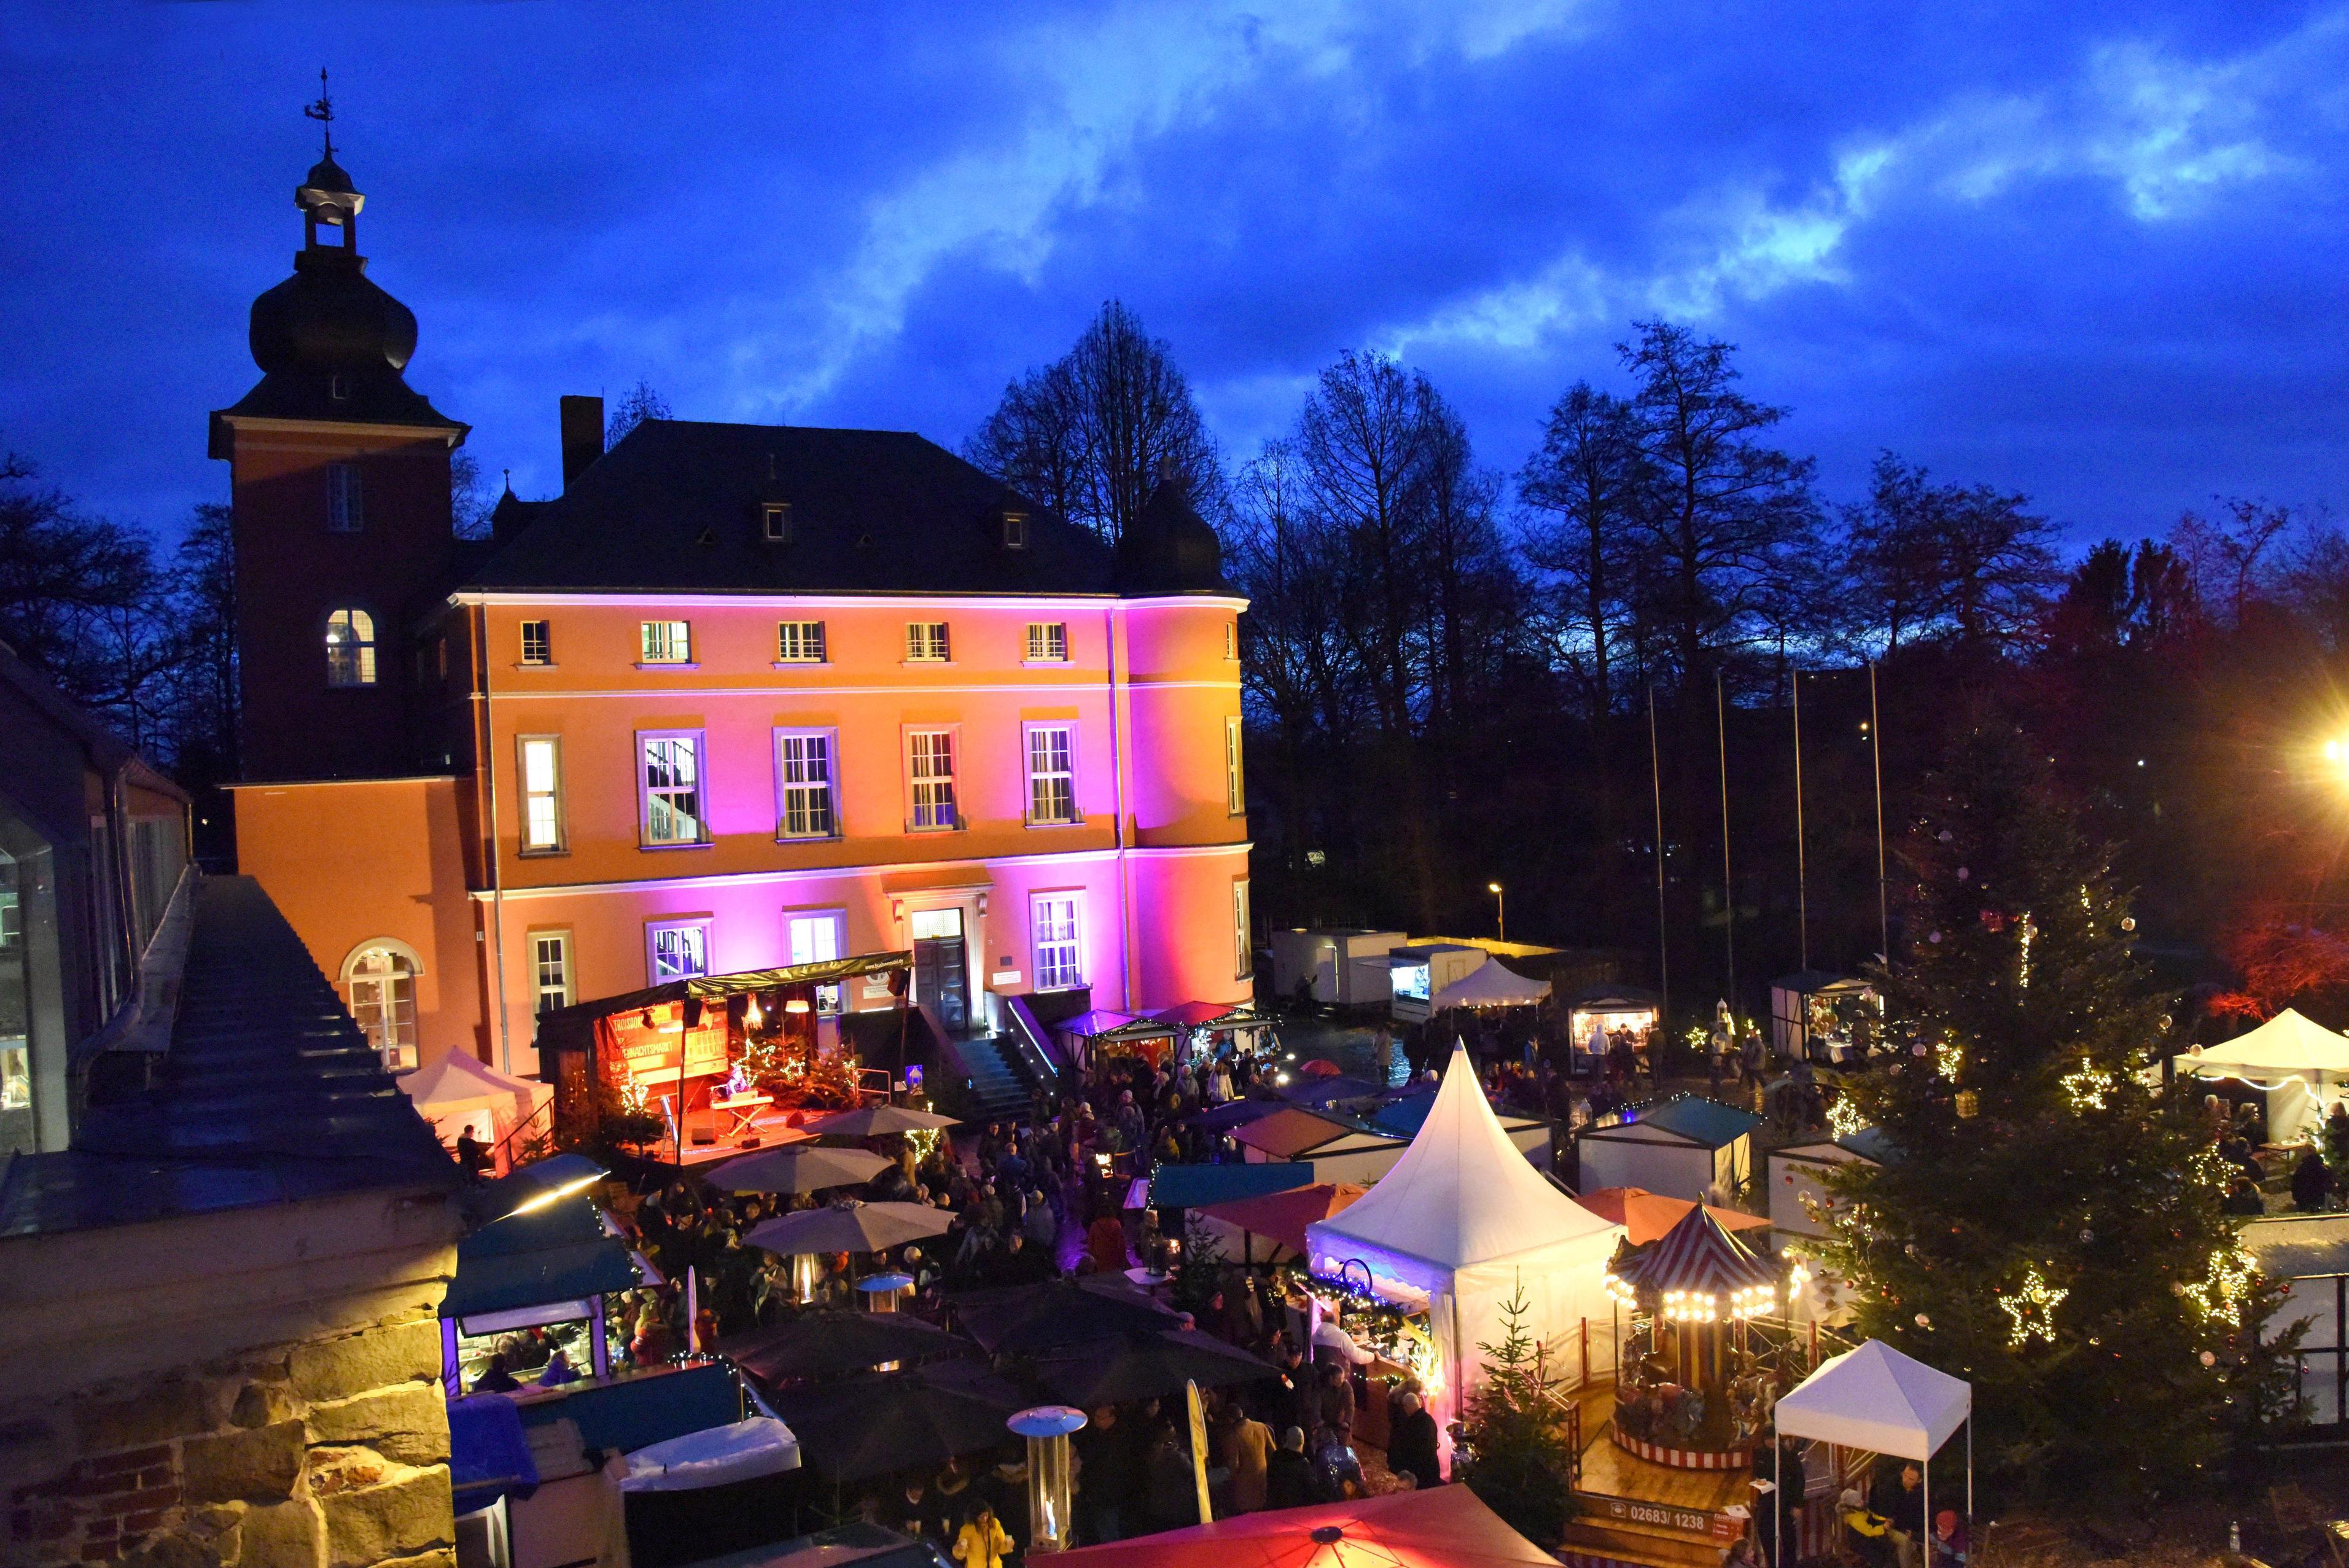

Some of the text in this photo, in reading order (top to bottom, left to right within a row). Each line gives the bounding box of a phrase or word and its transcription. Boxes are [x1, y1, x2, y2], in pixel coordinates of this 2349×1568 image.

[620, 1041, 672, 1058] EIHNACHTSMARKT
[1631, 1506, 1704, 1530] 02683/ 1238
